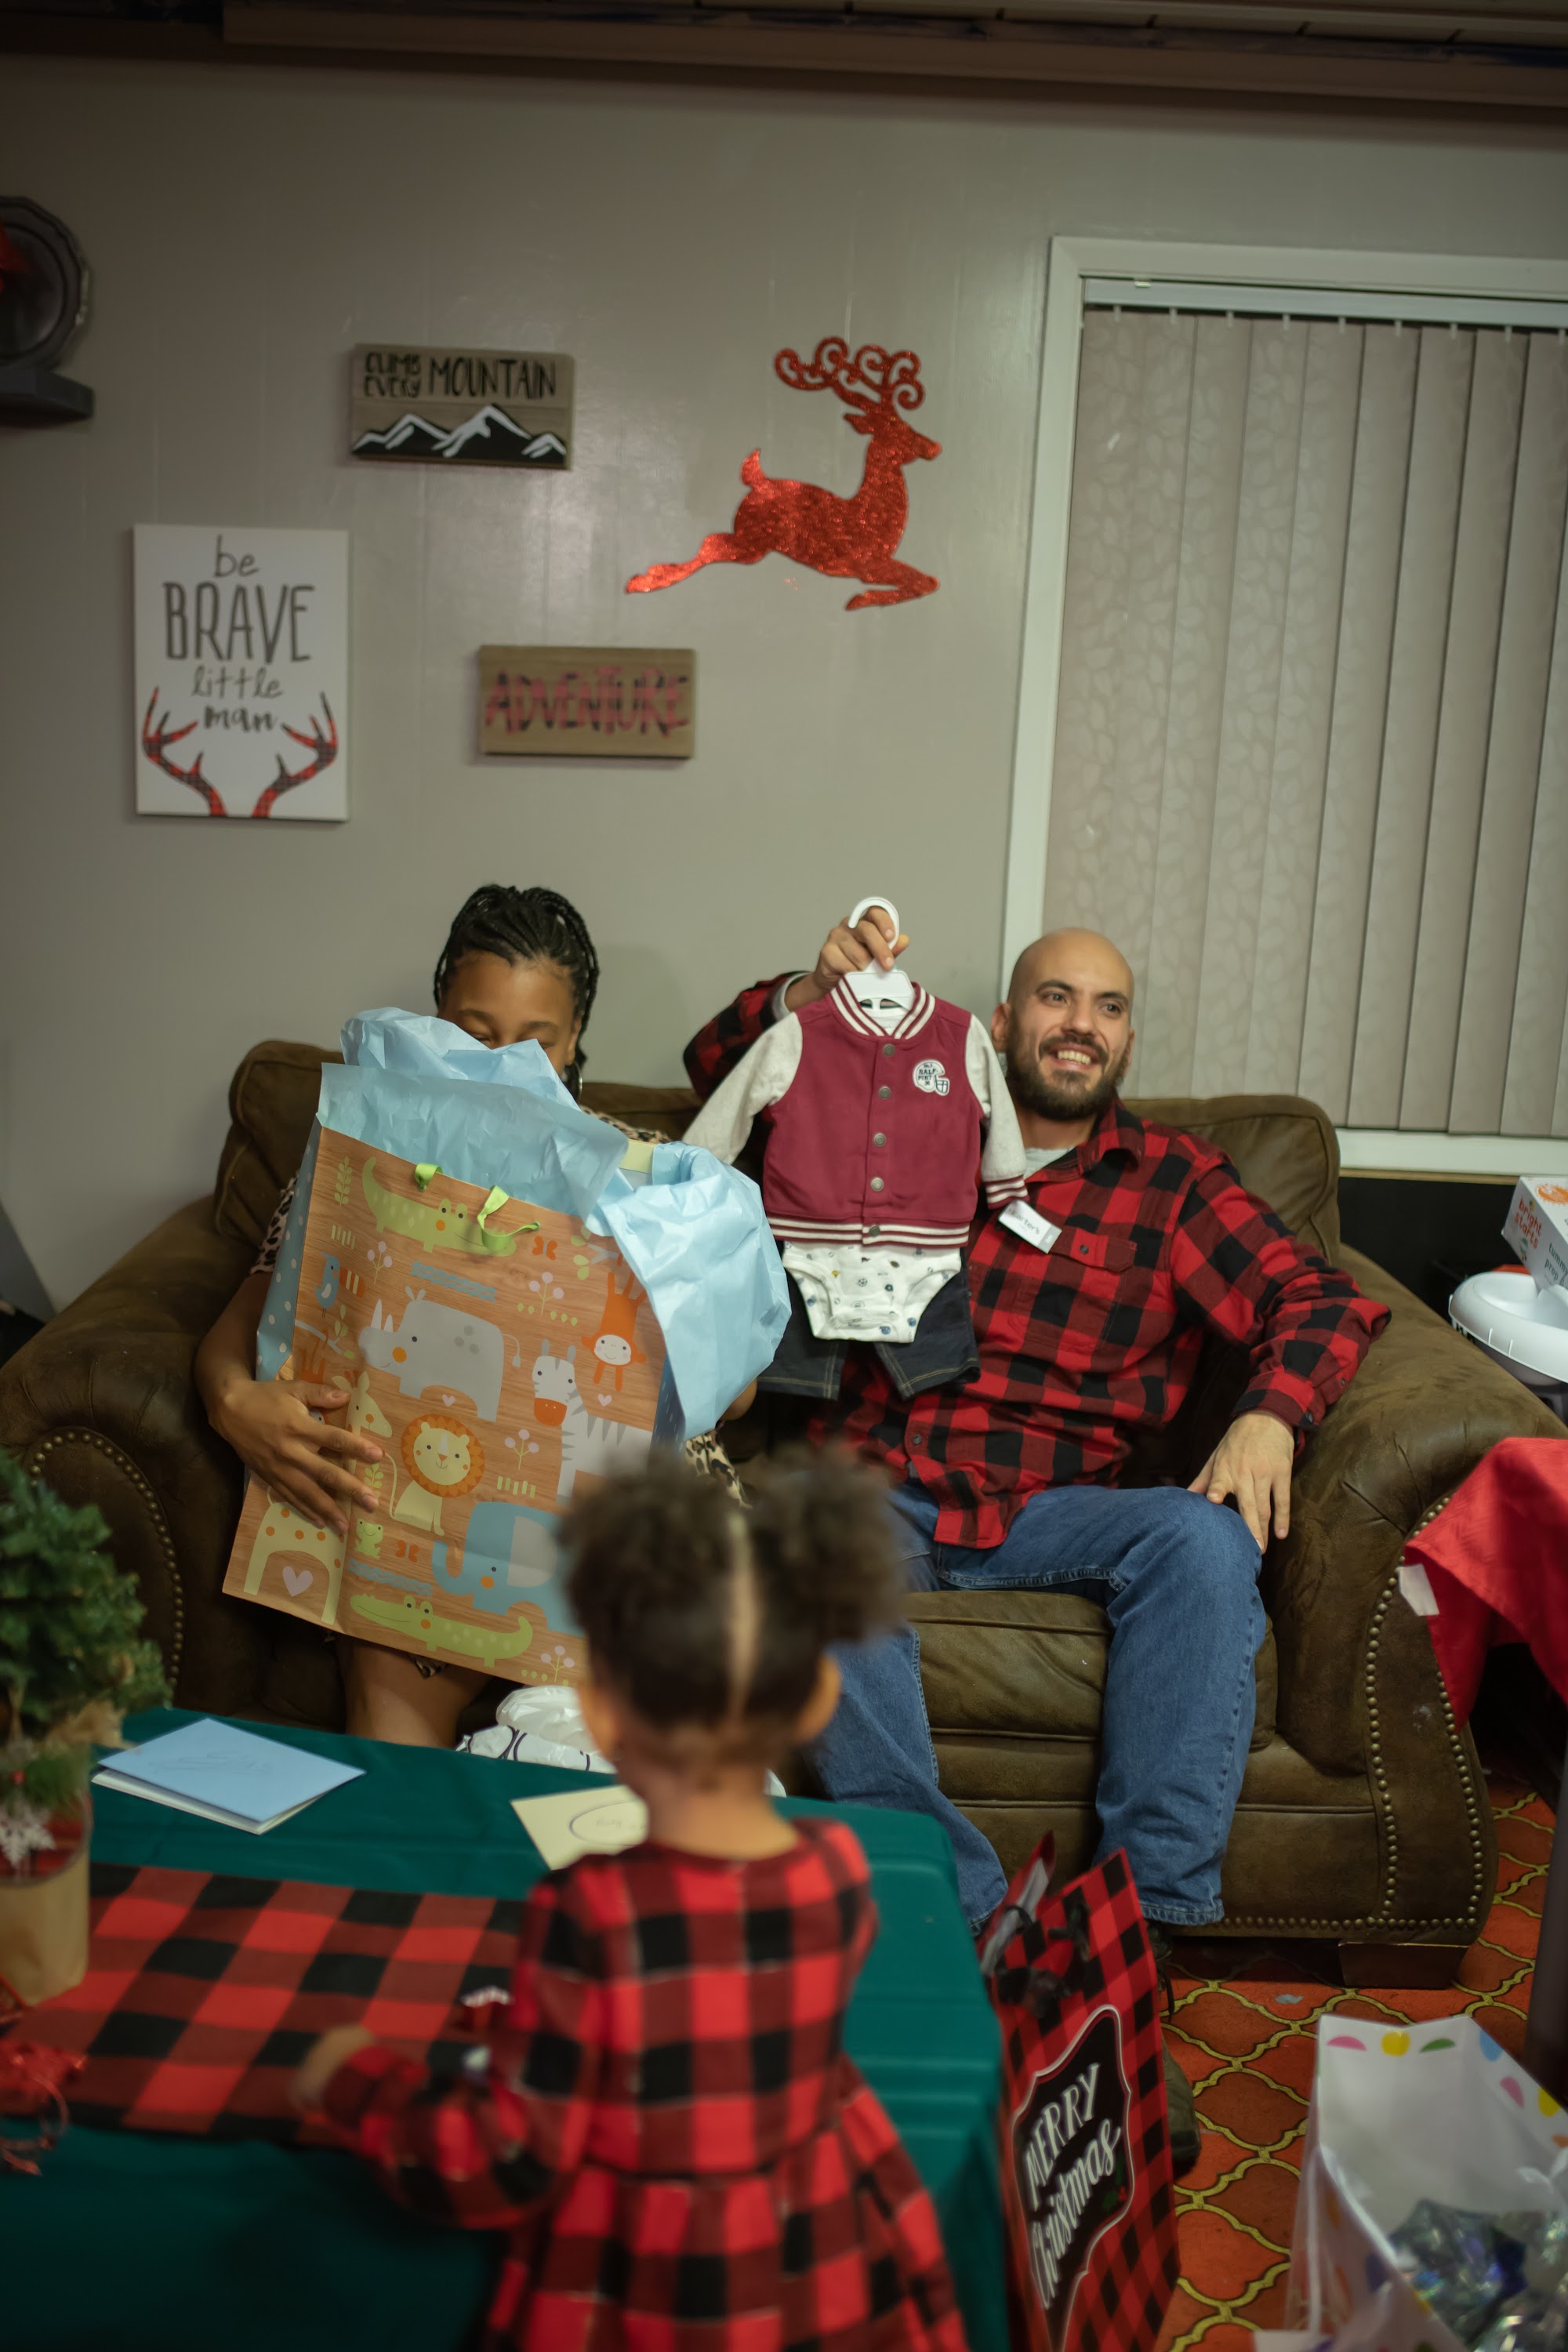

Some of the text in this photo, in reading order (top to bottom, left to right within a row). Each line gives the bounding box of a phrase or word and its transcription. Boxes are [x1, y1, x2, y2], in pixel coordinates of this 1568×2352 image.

[365, 352, 421, 375] CLIMB
[430, 356, 557, 400] MOUNTAIN
[363, 376, 421, 398] EVERY
[212, 534, 260, 579] be
[162, 581, 315, 665] BRAVE
[191, 665, 284, 699] little
[203, 706, 276, 733] man
[485, 666, 691, 739] ADVENTURE
[1515, 1211, 1538, 1249] starts
[1519, 1198, 1541, 1236] bright
[1544, 1258, 1559, 1283] prop
[1023, 2062, 1101, 2212] MERRY
[1031, 2118, 1121, 2310] Christmas
